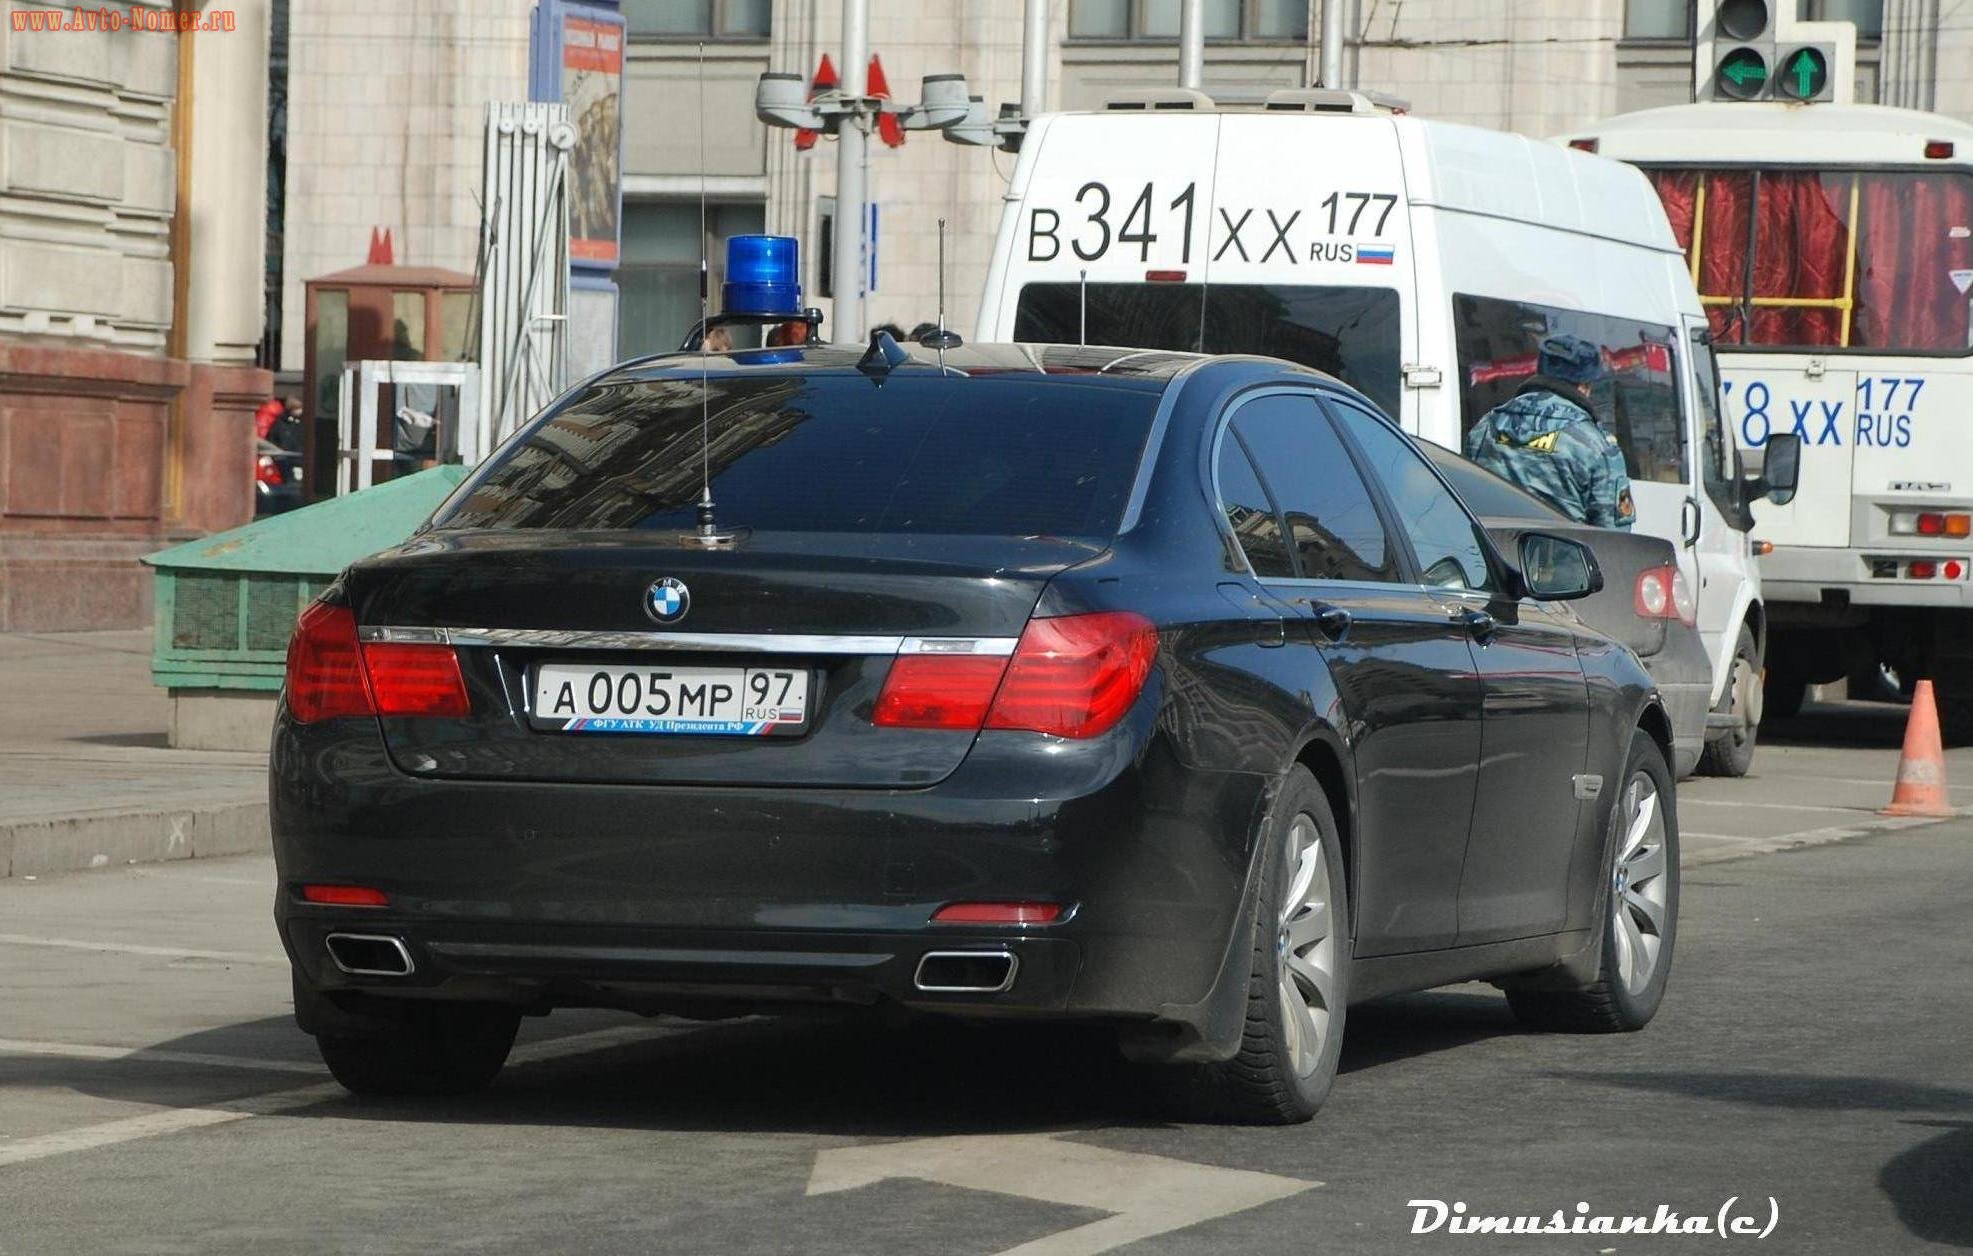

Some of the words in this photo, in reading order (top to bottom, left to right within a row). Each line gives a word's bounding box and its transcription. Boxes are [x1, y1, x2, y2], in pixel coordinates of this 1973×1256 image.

[1321, 191, 1398, 237] 177
[1309, 242, 1353, 263] RUS
[1857, 377, 1925, 411] 177
[1857, 414, 1911, 448] RUS
[553, 671, 733, 717] А005МР
[750, 673, 794, 706] 97
[593, 719, 620, 730] ФГУ
[649, 720, 664, 731] УД
[666, 721, 725, 733] Президента
[727, 722, 745, 732] РФ
[745, 708, 777, 720] RUS
